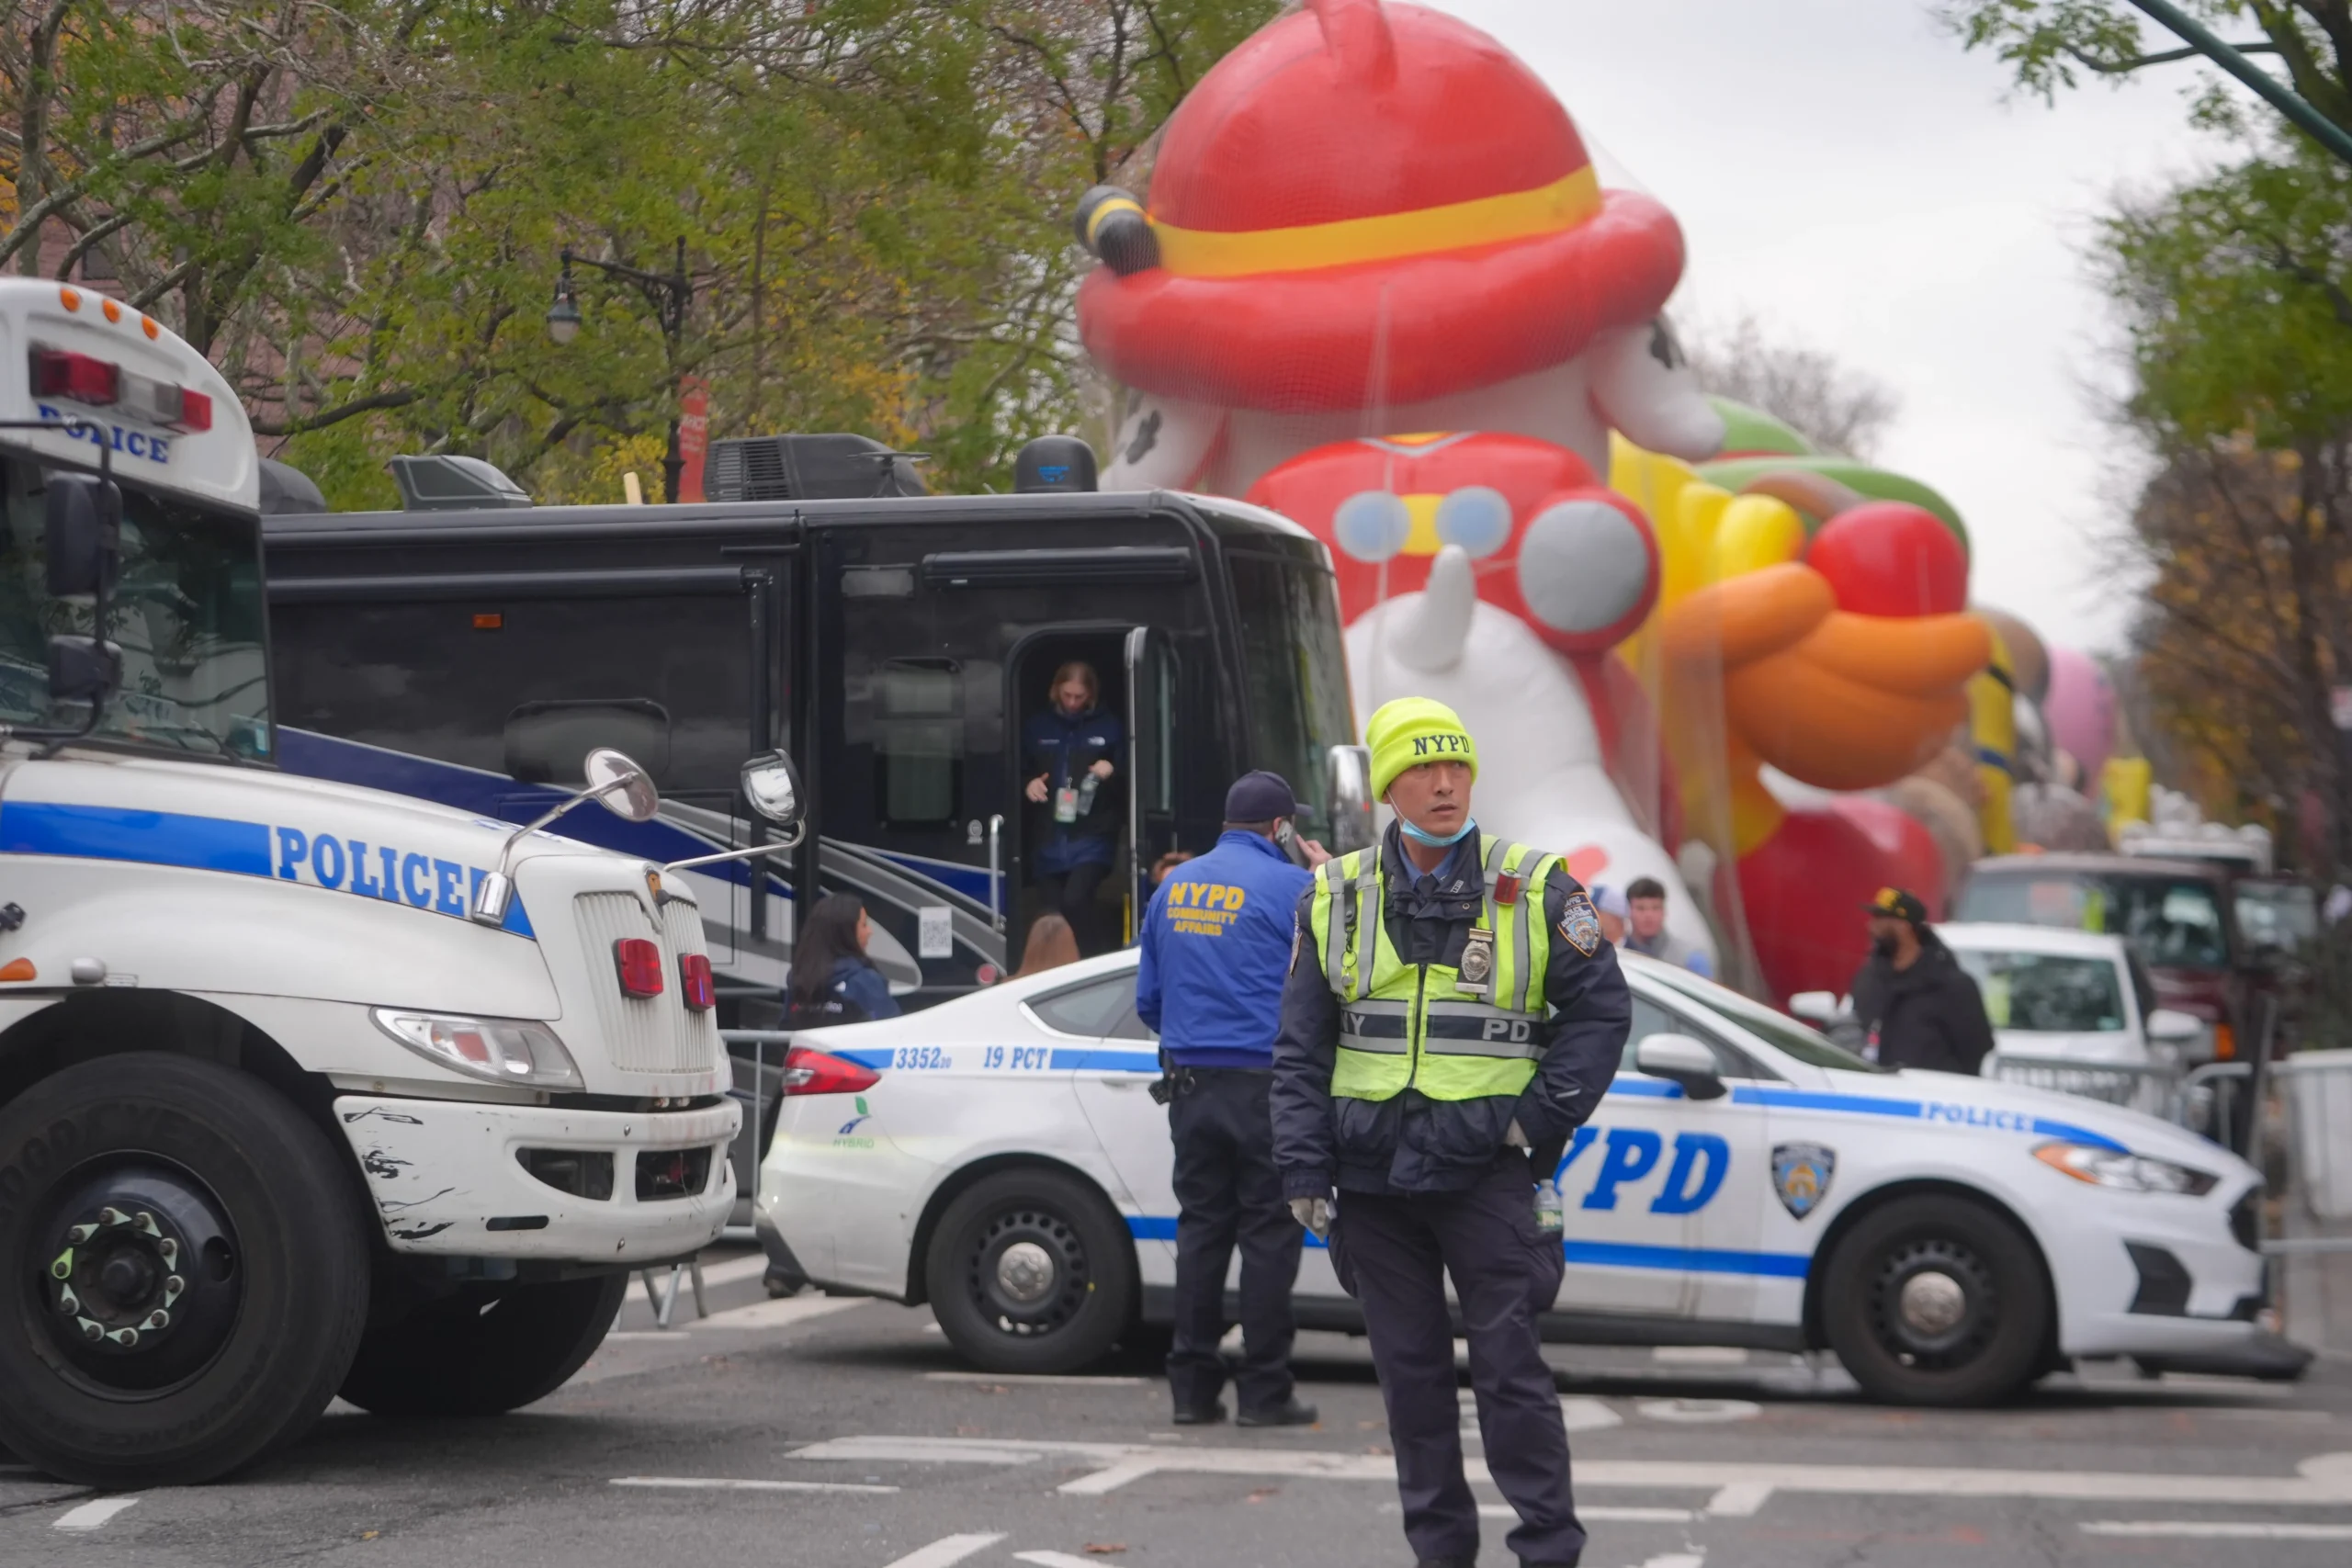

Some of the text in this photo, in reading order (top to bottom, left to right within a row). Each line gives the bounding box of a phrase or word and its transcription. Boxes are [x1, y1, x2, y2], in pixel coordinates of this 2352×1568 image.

[1413, 735, 1470, 756] NYPD
[277, 826, 465, 918] POLICE
[1168, 882, 1245, 910] NYPD
[1167, 907, 1238, 925] COMMUNITY
[1173, 919, 1222, 936] AFFAIRS
[1482, 1018, 1531, 1042] PD
[984, 1046, 1047, 1069] 19 PCT
[1928, 1101, 2028, 1131] POLICE
